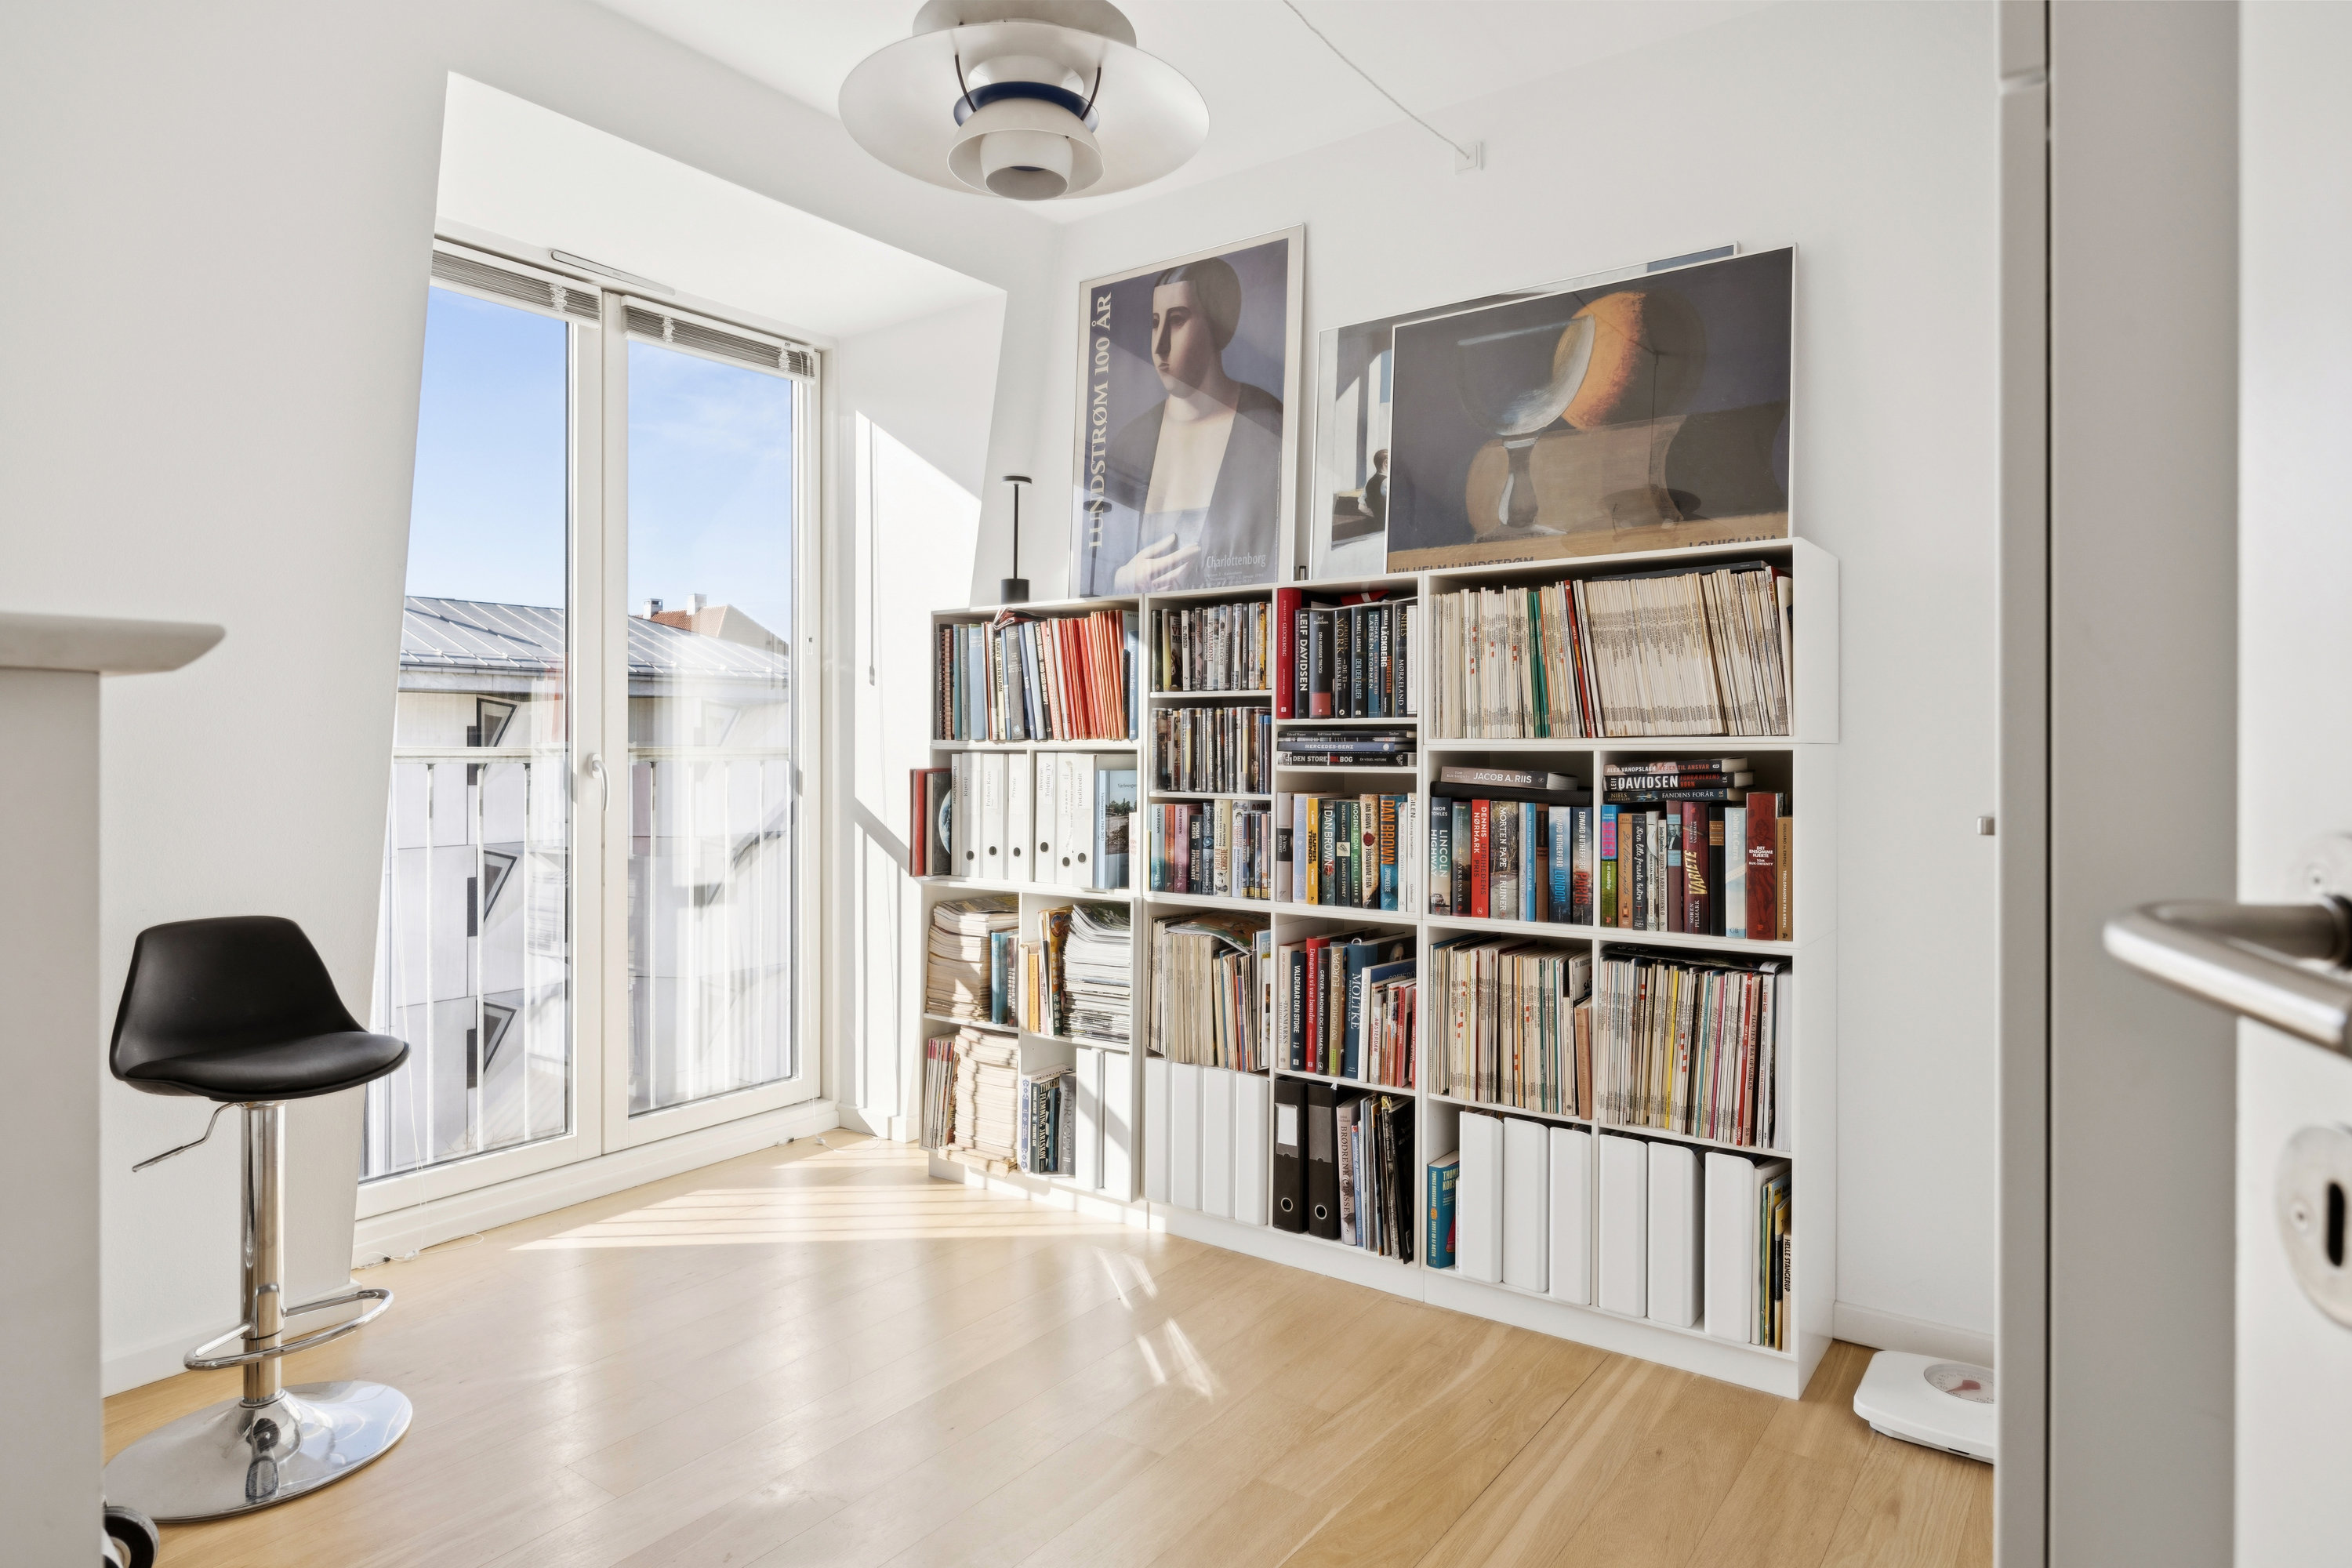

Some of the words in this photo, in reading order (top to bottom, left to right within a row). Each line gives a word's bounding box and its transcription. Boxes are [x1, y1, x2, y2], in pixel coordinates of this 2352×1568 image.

[1091, 292, 1112, 331] ÅR
[1094, 337, 1110, 375] 100
[1088, 381, 1108, 549] LUNDSTRØM
[1207, 552, 1266, 568] Charlottenborg
[1473, 772, 1504, 781] JACOB
[1617, 775, 1679, 791] DAVIDSEN
[1324, 810, 1333, 829] DAN
[1381, 800, 1395, 822] DAN
[1324, 832, 1333, 866] BROWN
[1381, 824, 1395, 865] BROWN
[1635, 826, 1644, 842] Den
[1636, 844, 1645, 856] lille
[1439, 829, 1448, 877] LINCOLN
[1634, 857, 1644, 882] franske
[1555, 869, 1566, 902] LONDON
[1574, 871, 1589, 905] PARIS
[1351, 973, 1362, 1029] MOLTKE
[1341, 1127, 1349, 1174] BRØDRENE
